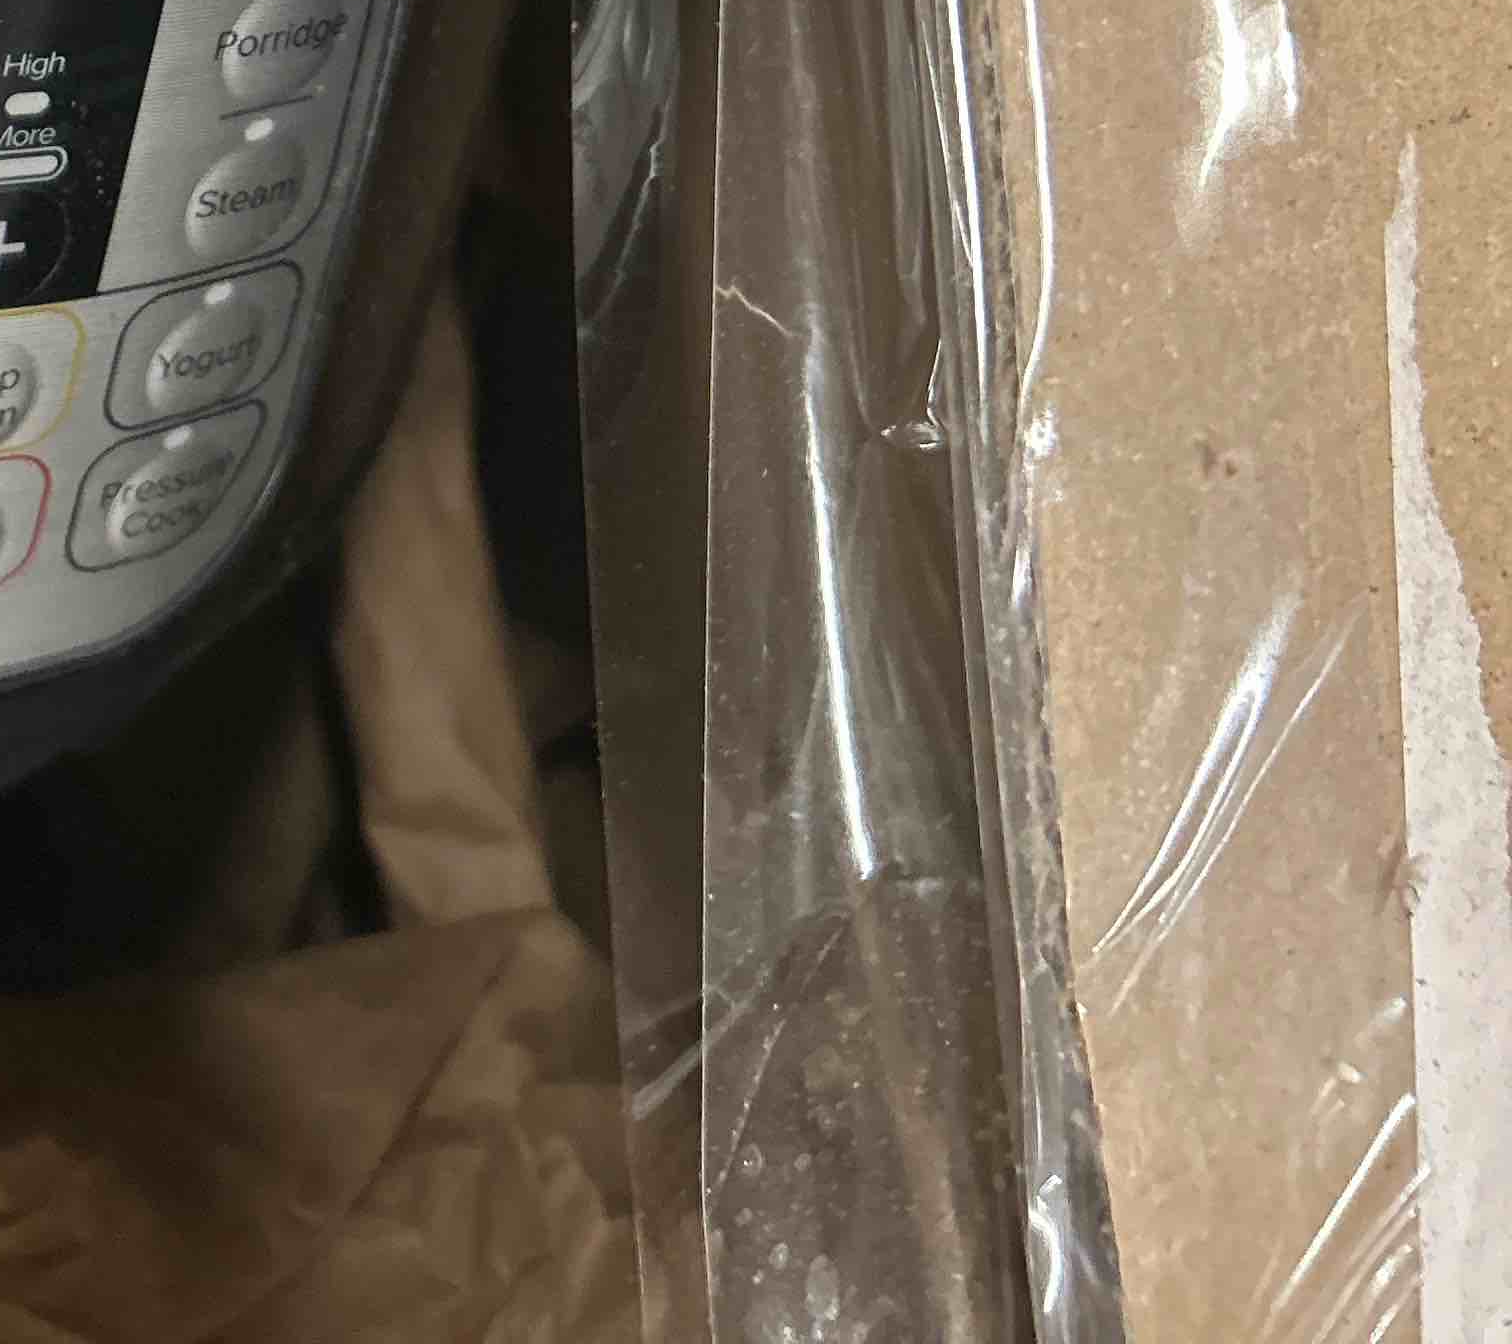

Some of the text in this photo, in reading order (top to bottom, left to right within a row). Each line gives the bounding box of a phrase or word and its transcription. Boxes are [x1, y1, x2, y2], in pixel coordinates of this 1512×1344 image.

[214, 13, 349, 62] Porridge
[2, 51, 66, 81] High
[194, 178, 297, 219] Steam
[121, 500, 210, 539] Co
